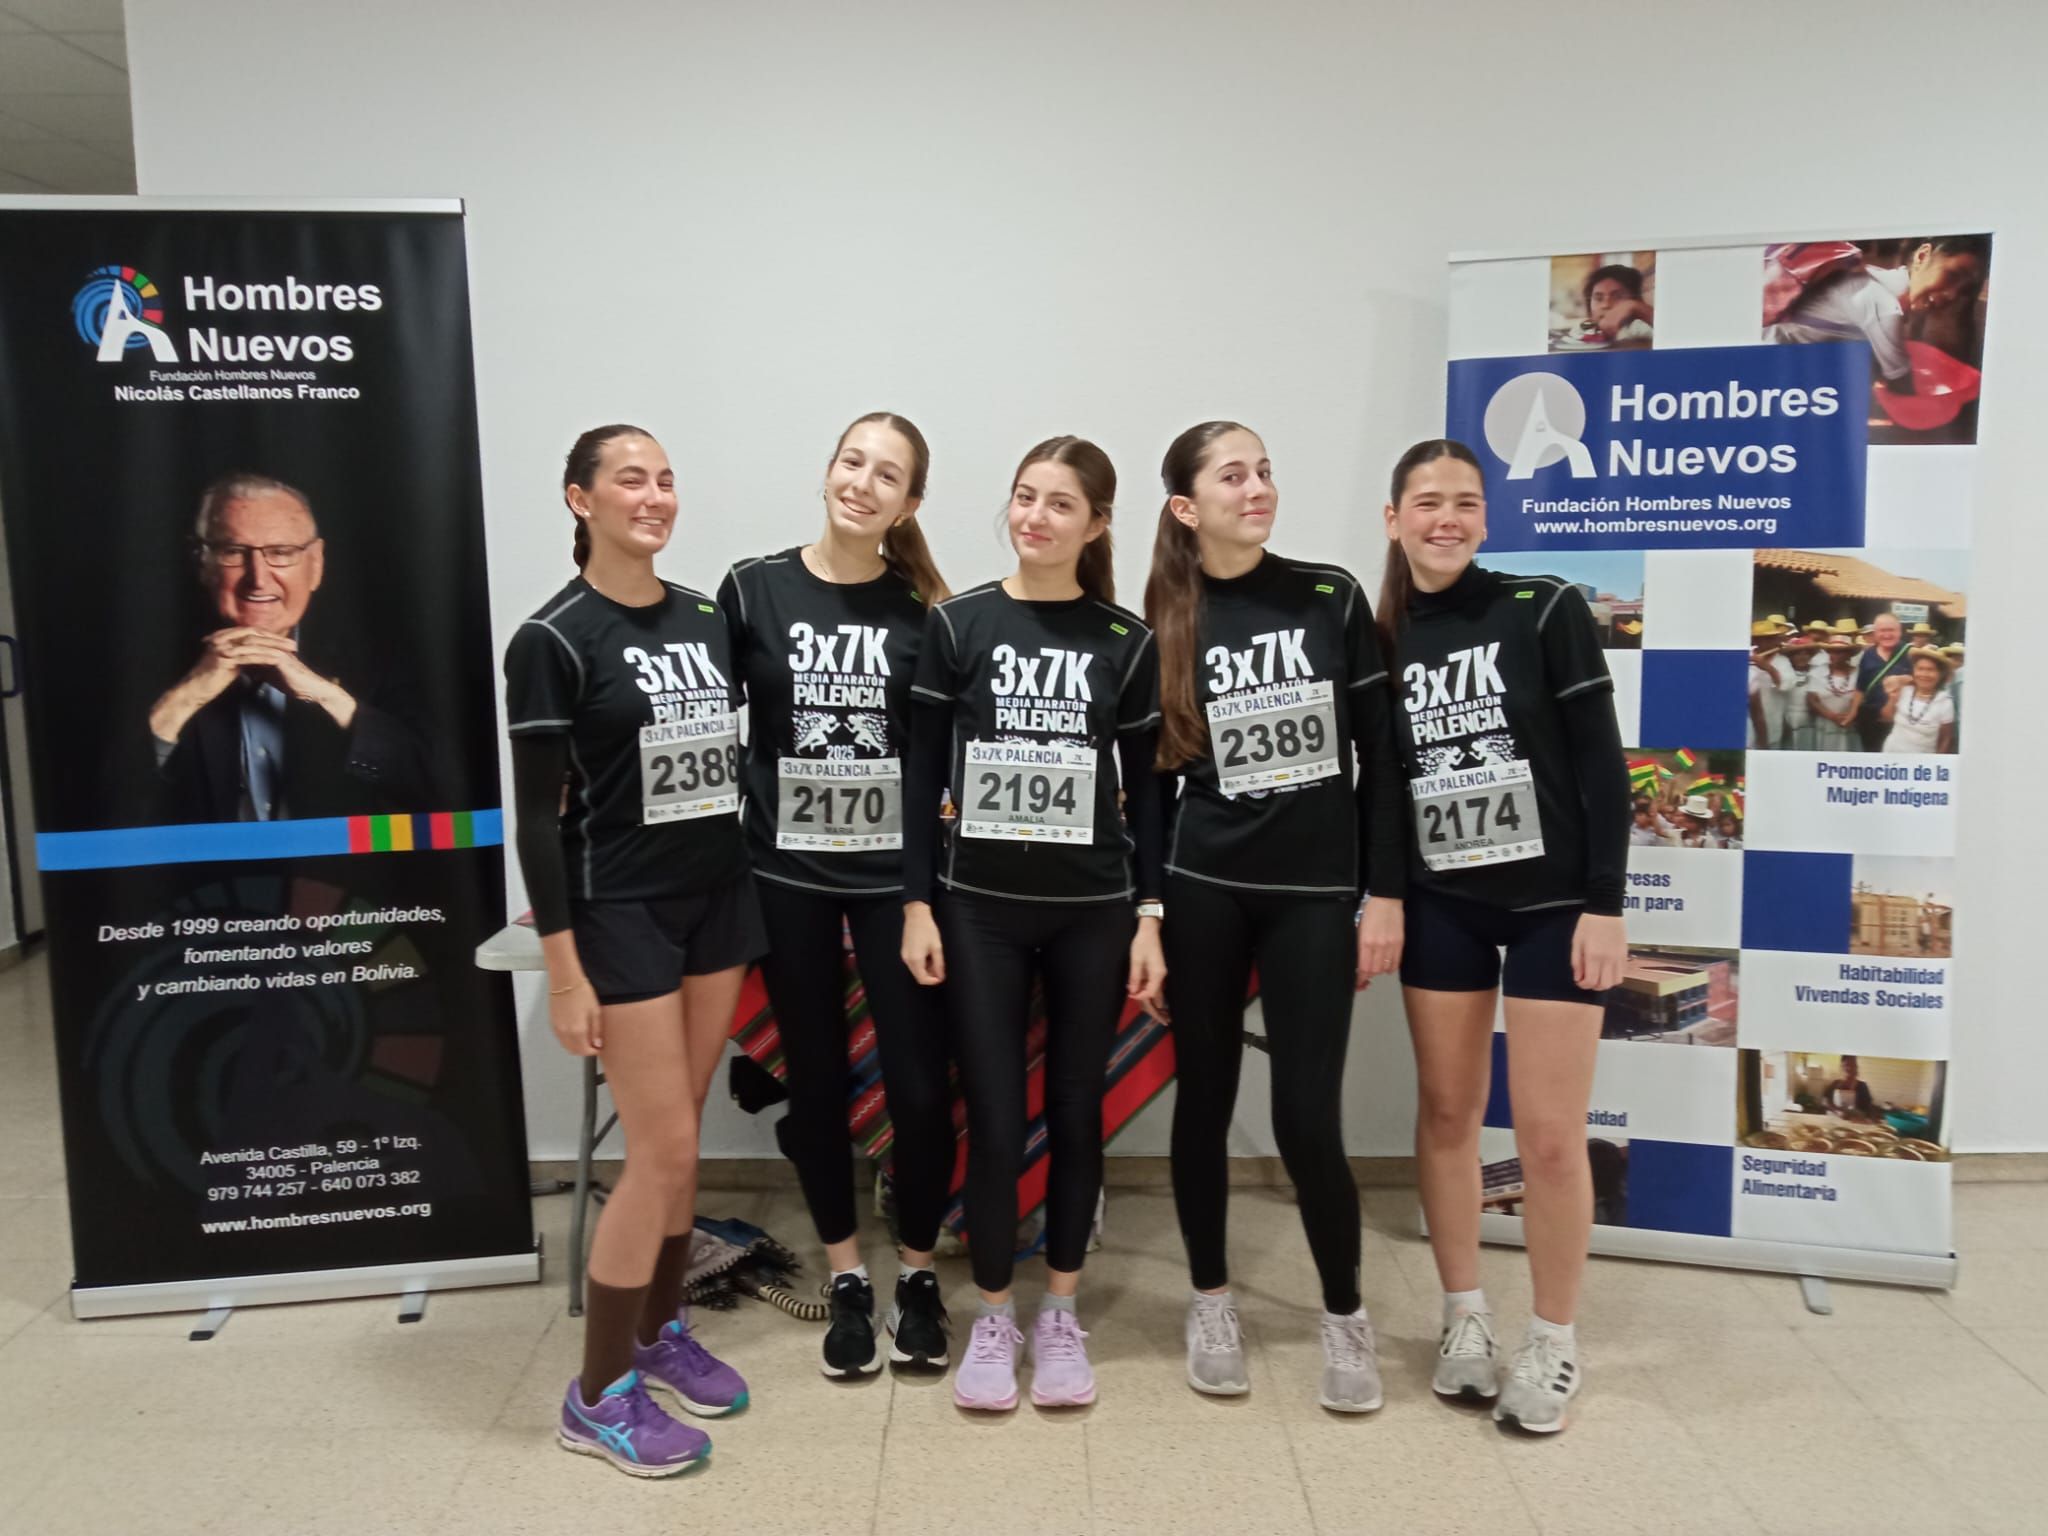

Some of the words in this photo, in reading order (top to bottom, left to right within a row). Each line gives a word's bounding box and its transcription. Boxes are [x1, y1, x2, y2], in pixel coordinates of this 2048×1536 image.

[184, 276, 382, 311] Hombres
[188, 327, 354, 362] Nuevos
[150, 369, 212, 382] Fundación
[214, 368, 268, 381] Hombres
[270, 368, 316, 380] Nuevos
[114, 384, 184, 401] Nicolás
[189, 384, 293, 400] Castellanos
[298, 383, 360, 399] Franco
[1611, 381, 1840, 422] Hombres
[1609, 438, 1799, 477] Nuevos
[1522, 497, 1620, 514] Fundación
[1625, 495, 1712, 511] Hombres
[1718, 494, 1792, 510] Nuevos
[1535, 516, 1777, 534] www.hombresnuevos.org
[788, 622, 891, 676] 3x7K
[1205, 629, 1314, 694] 3x7K
[623, 643, 729, 694] 3x7K
[794, 673, 829, 684] MEDIA
[833, 673, 886, 688] MARATÓN
[991, 644, 1094, 702] 3x7K
[1403, 641, 1507, 713] 3x7K
[793, 684, 886, 709] PALENCIA
[996, 697, 1031, 708] MEDIA
[1034, 699, 1087, 712] MARATÓN
[1212, 701, 1245, 718] 3x7K
[1245, 692, 1302, 713] PALENCIA
[1410, 707, 1445, 723] MEDIA
[1448, 694, 1502, 716] MARATÓN
[652, 700, 729, 725] PALENCIA
[996, 708, 1087, 735] PALENCIA
[677, 720, 725, 738] PALENCIA
[1411, 707, 1508, 745] PALENCIA
[826, 745, 855, 760] 2025
[1220, 714, 1325, 768] 2389
[973, 747, 1002, 761] 3x7K
[1006, 749, 1063, 764] PALENCIA
[784, 762, 813, 775] 3x7K
[815, 764, 872, 777] PALENCIA
[1440, 770, 1497, 791] PALENCIA
[1817, 762, 1908, 781] Promoción
[1913, 763, 1932, 781] de
[1937, 764, 1950, 782] la
[792, 786, 885, 825] 2170
[977, 772, 1076, 815] 2194
[1826, 787, 1879, 806] Mujer
[1884, 787, 1949, 808] Indígena
[1008, 814, 1045, 824] AMALIA
[1423, 792, 1521, 843] 2174
[1455, 838, 1495, 850] ANDREA
[1626, 872, 1671, 887] resas
[1645, 896, 1684, 912] para
[98, 923, 164, 942] Desde
[171, 918, 219, 936] 1999
[224, 914, 301, 934] creando
[306, 906, 446, 931] oportunidades,
[184, 944, 297, 964] fomentando
[302, 939, 372, 959] valores
[137, 982, 151, 1001] y
[155, 973, 261, 996] cambiando
[266, 969, 316, 989] vidas
[321, 971, 346, 985] en
[352, 963, 419, 982] Bolivia.
[1839, 964, 1944, 986] Habitabilidad
[1795, 985, 1870, 1007] Vivendas
[1875, 988, 1944, 1010] Sociales
[1586, 1110, 1628, 1127] sidad
[200, 1149, 265, 1165] Avenida
[268, 1144, 332, 1161] Castilla,
[336, 1140, 357, 1154] 59
[393, 1135, 422, 1151] Izq.
[246, 1164, 296, 1180] 34005
[311, 1157, 380, 1175] Palencia
[1742, 1155, 1827, 1178] Seguridad
[208, 1187, 238, 1201] 979
[243, 1184, 272, 1198] 744
[276, 1181, 306, 1196] 257
[322, 1177, 351, 1192] 640
[356, 1174, 386, 1189] 073
[390, 1170, 421, 1185] 382
[1742, 1179, 1837, 1202] Alimentaria
[202, 1202, 431, 1234] www.hombresnuevos.org
